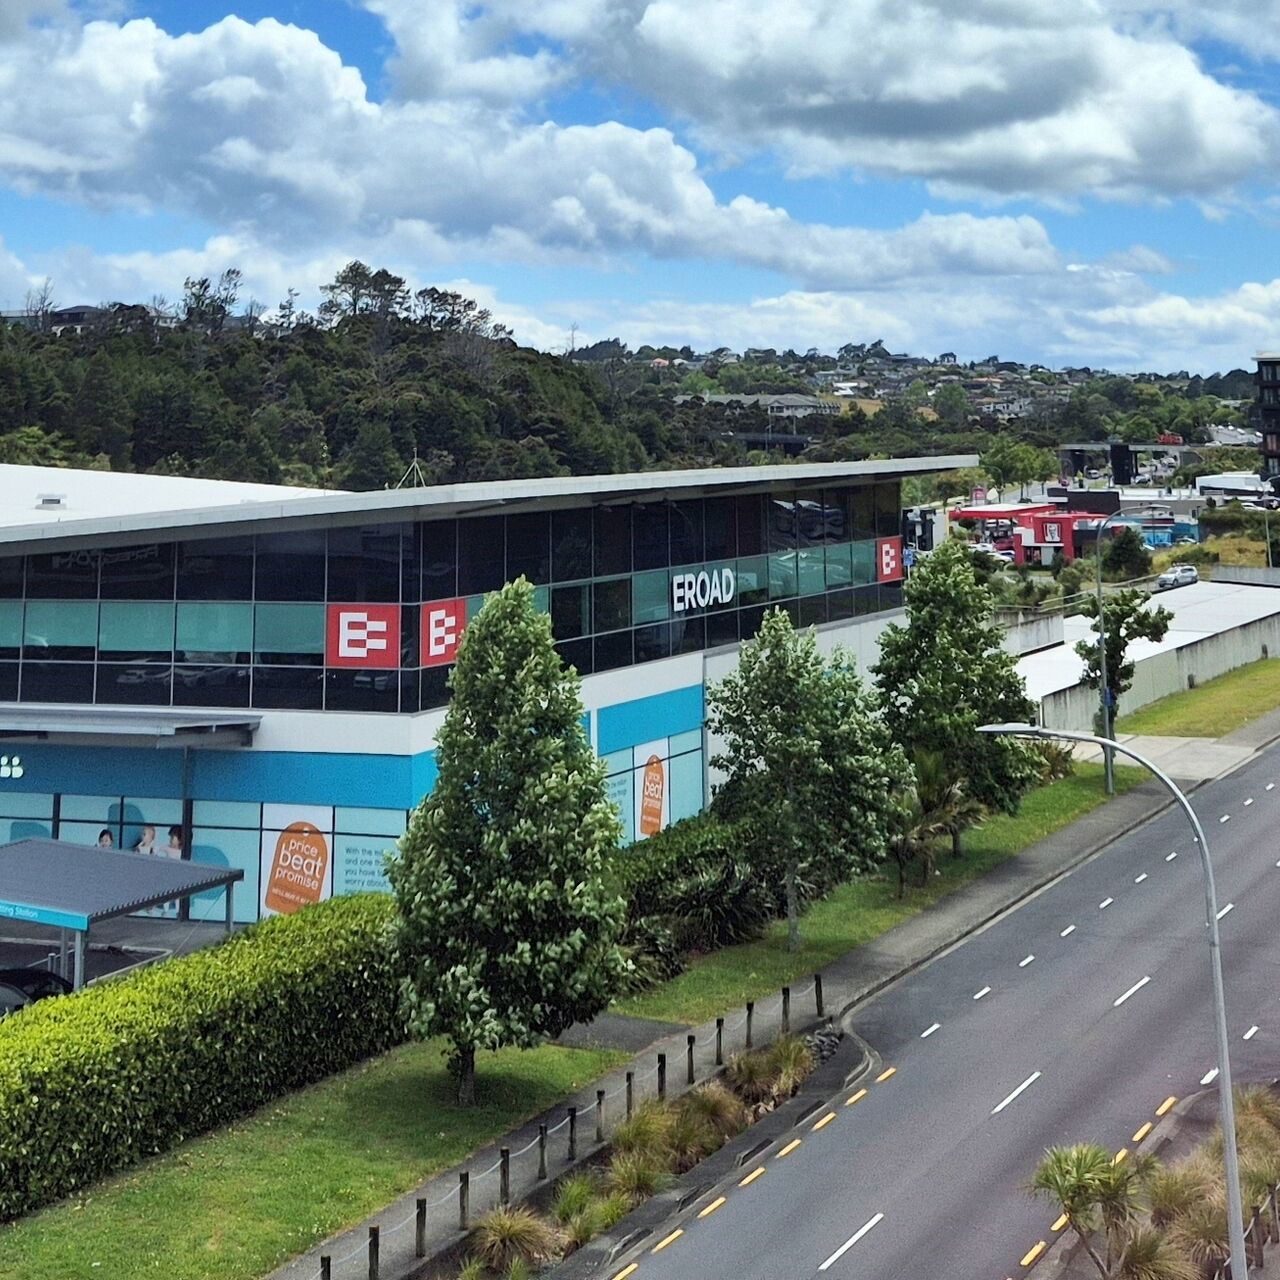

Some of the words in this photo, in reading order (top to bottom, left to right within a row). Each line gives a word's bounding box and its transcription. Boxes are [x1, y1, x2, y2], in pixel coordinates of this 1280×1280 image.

[672, 568, 735, 612] EROAD
[288, 839, 318, 856] price
[345, 847, 360, 855] With
[361, 848, 373, 856] the
[278, 843, 323, 878] beat
[345, 858, 359, 866] and
[275, 867, 319, 891] promise
[345, 880, 365, 888] worry
